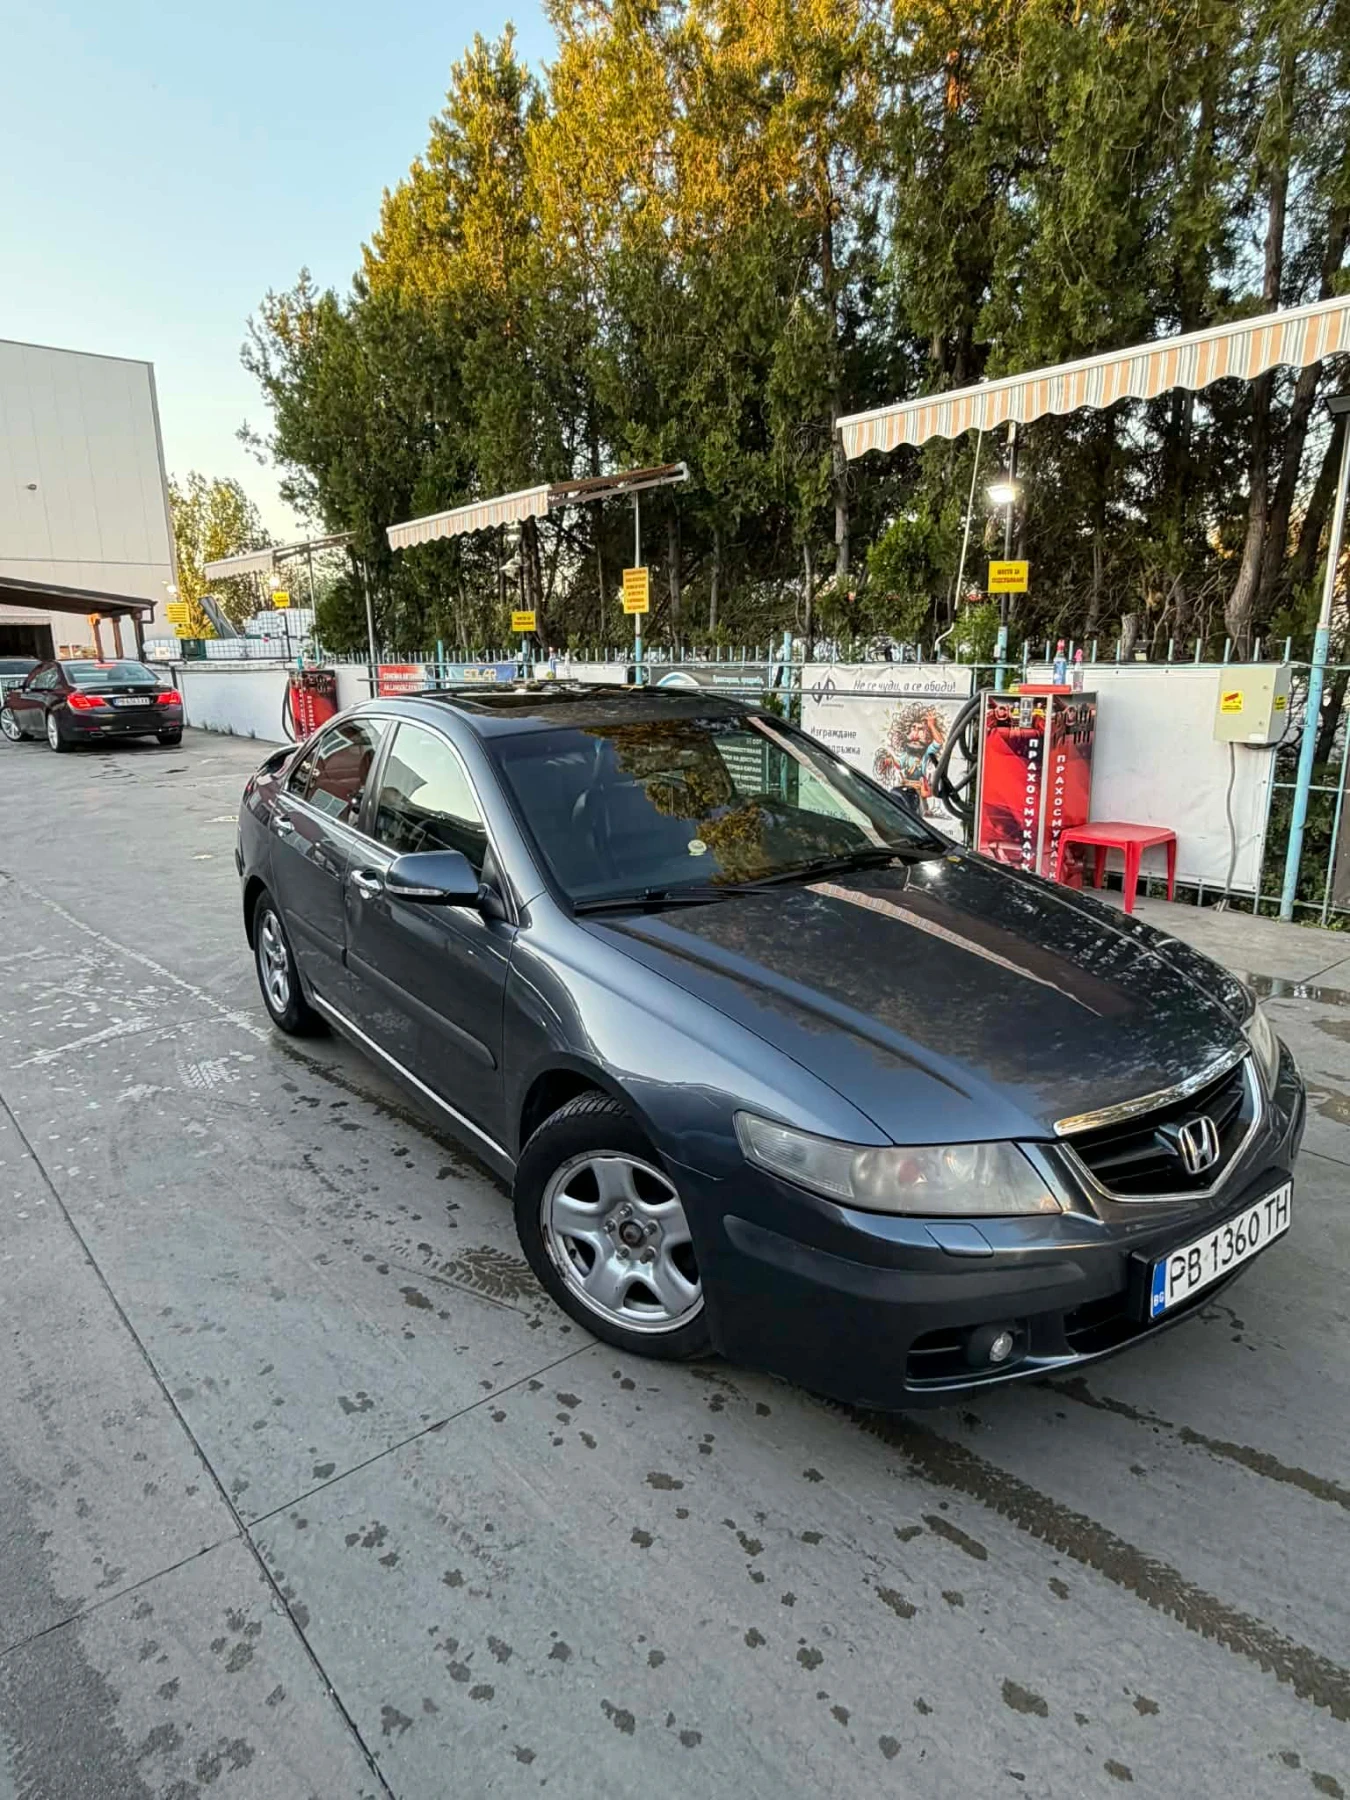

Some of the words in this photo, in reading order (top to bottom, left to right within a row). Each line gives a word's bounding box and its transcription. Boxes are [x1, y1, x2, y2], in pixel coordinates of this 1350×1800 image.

[854, 680, 865, 690] Не
[912, 682, 922, 691] се
[924, 681, 956, 692] обади!
[810, 726, 857, 739] Изграждане
[1170, 1248, 1201, 1297] PB
[1210, 1211, 1260, 1272] 1360
[1264, 1190, 1288, 1236] TH
[1153, 1291, 1165, 1307] BG
